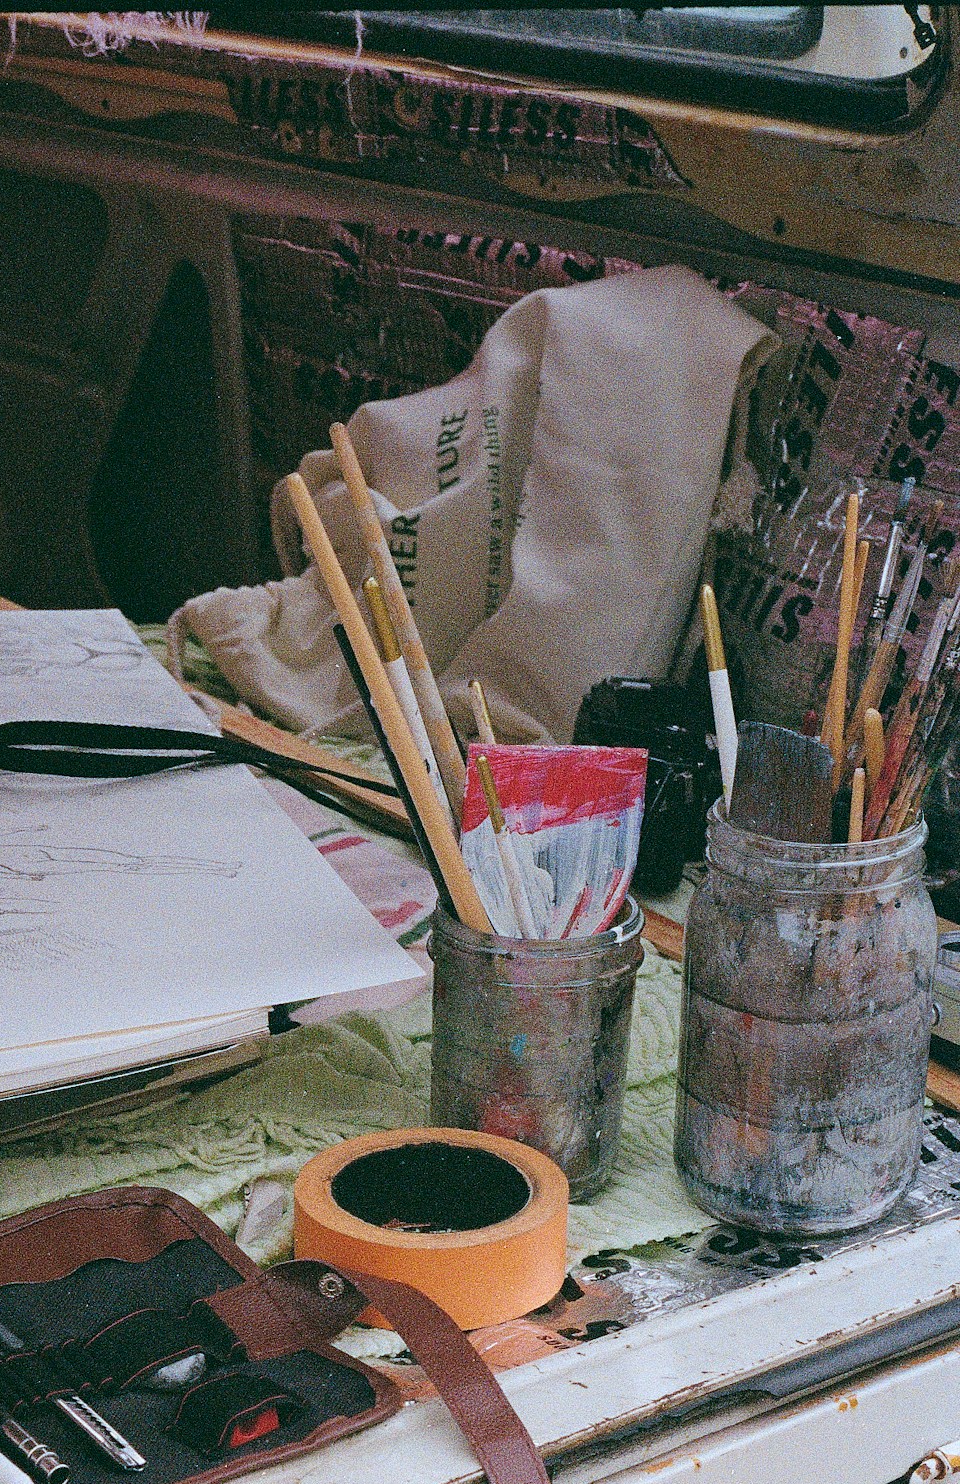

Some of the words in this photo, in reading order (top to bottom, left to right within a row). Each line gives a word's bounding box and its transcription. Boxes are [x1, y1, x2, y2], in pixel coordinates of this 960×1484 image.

[480, 406, 500, 457] thing
[486, 463, 501, 511] wild
[390, 513, 420, 607] HER
